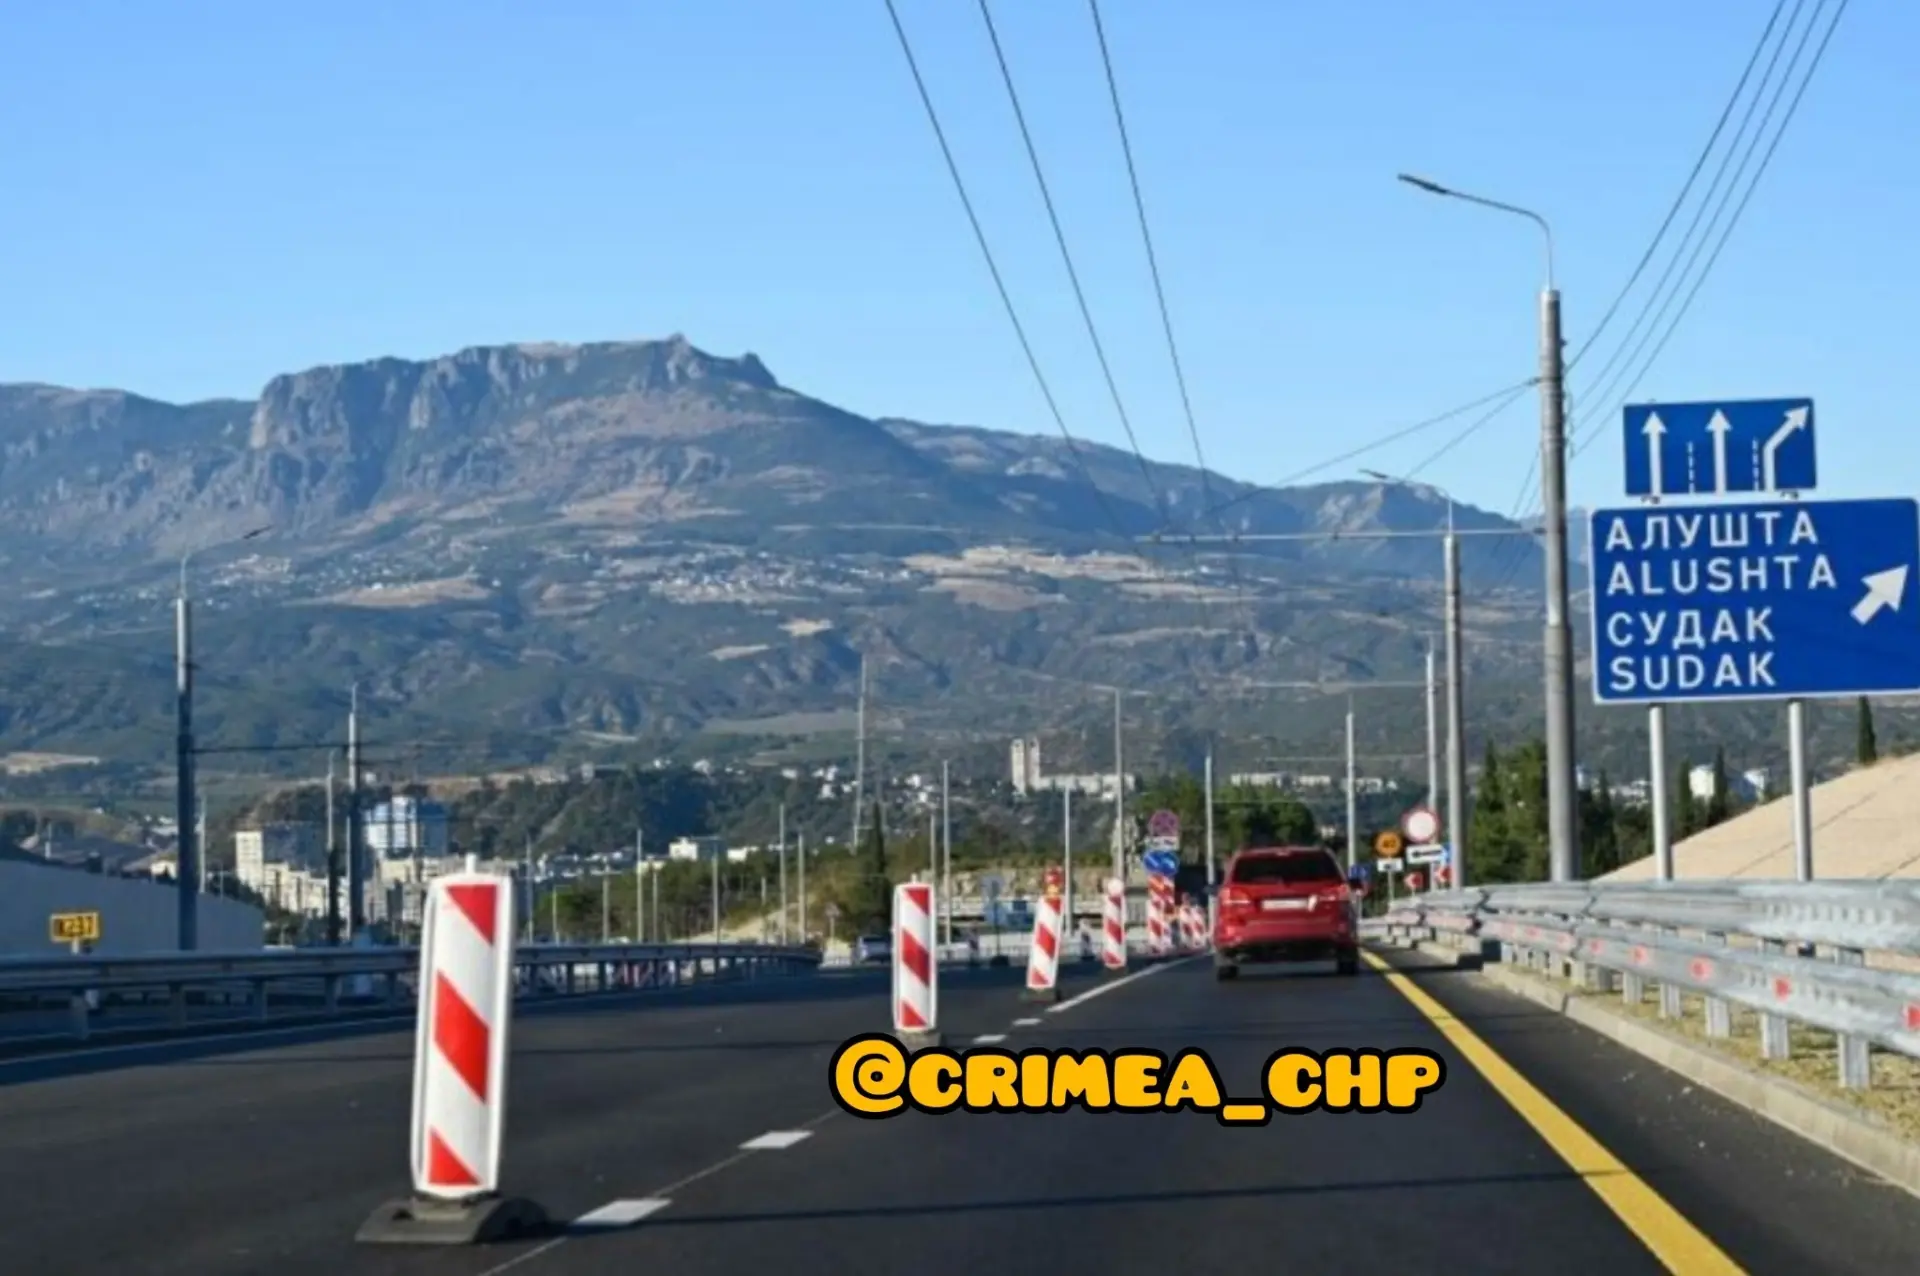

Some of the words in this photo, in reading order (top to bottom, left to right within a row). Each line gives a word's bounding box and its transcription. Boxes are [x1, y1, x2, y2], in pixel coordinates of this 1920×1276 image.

[1605, 510, 1819, 551] АЛУШТА
[1606, 553, 1838, 596] ALUSHTA
[1606, 606, 1775, 650] СУДАК
[1609, 651, 1776, 691] SUDAK
